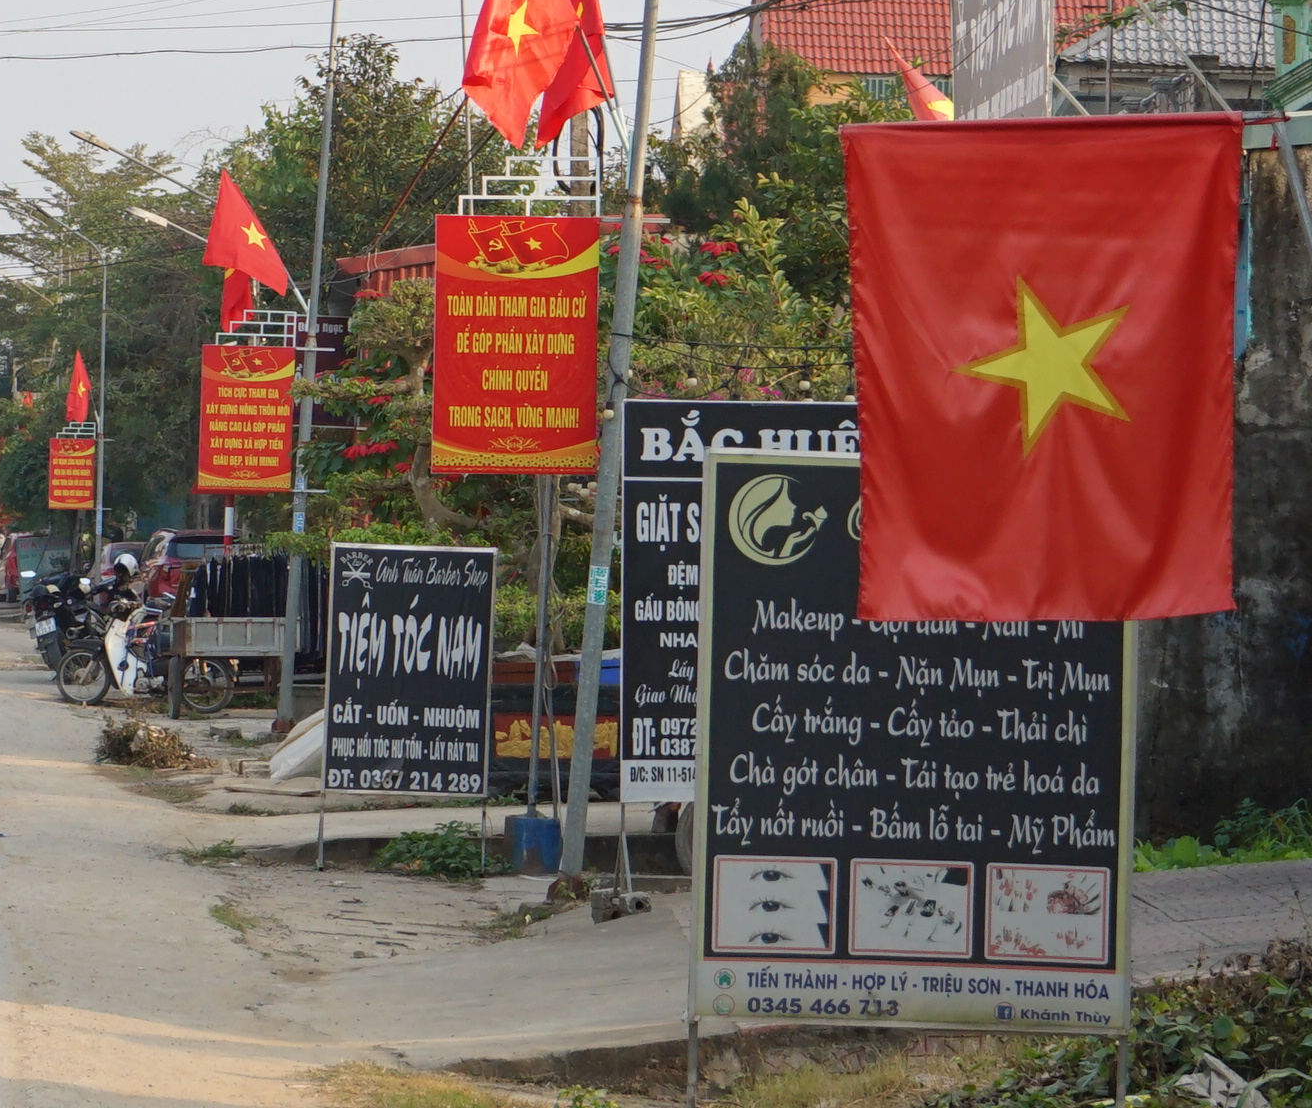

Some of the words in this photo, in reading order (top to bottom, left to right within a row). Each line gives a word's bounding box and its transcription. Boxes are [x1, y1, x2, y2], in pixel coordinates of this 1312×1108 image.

[447, 291, 473, 316] TOÀN
[476, 291, 496, 317] DÂN
[499, 296, 527, 317] THAM
[530, 296, 547, 317] GIA
[572, 290, 587, 318] CỬ
[322, 323, 344, 335] Ngọc
[457, 324, 470, 353] ĐỂ
[473, 328, 492, 353] GÓP
[525, 329, 545, 354] XÂY
[547, 333, 575, 359] DỰNG
[218, 385, 232, 398] TÍCH
[248, 388, 267, 399] THAM
[268, 388, 279, 399] GIA
[482, 365, 513, 391] CHÍNH
[206, 401, 218, 414] XÂY
[220, 403, 238, 417] DỰNG
[239, 403, 258, 415] NÔNG
[259, 404, 276, 416] THÔN
[449, 406, 481, 427] TRONG
[484, 406, 513, 432] SẠCH,
[517, 403, 543, 428] VỮNG
[546, 407, 579, 433] MẠNH!
[209, 419, 228, 432] NÂNG
[229, 421, 243, 432] CAO
[252, 420, 266, 433] GÓP
[640, 409, 744, 462] BẮC
[210, 436, 223, 448] XÂY
[224, 437, 243, 451] DỰNG
[259, 456, 280, 467] MINH!
[636, 493, 681, 552] GIẶT
[686, 502, 701, 543] S
[340, 551, 374, 566] BARBER
[425, 557, 461, 586] Barber
[463, 558, 488, 593] Shop
[667, 560, 699, 590] ĐỆM
[634, 593, 663, 622] GẤU
[752, 597, 844, 642] Makeup
[338, 591, 387, 689] TIỆM
[391, 593, 433, 676] TÓC
[436, 614, 482, 681] NAM
[724, 648, 790, 684] Chăm
[797, 653, 836, 682] sóc
[842, 651, 871, 685] da
[894, 656, 943, 695] Nặn
[949, 657, 1000, 698] Mụn
[1021, 658, 1053, 700] Trị
[1060, 661, 1111, 702] Mụn
[634, 683, 667, 708] Giao
[333, 697, 363, 724] CẮT
[377, 699, 409, 726] UỐN
[423, 705, 480, 732] NHUỘM
[752, 694, 797, 744] Cấy
[804, 696, 862, 745] trắng
[887, 698, 932, 747] Cấy
[939, 709, 974, 738] tảo
[996, 708, 1047, 743] Thải
[1054, 710, 1088, 745] chì
[331, 737, 355, 761] PHỤC
[373, 735, 389, 758] TÓC
[429, 734, 445, 761] LẤY
[447, 738, 465, 762] RÁY
[466, 742, 479, 762] TAI
[632, 718, 656, 756] ĐT:
[660, 718, 697, 735] 0972
[327, 768, 355, 788] ĐT:
[409, 771, 443, 791] 214
[447, 773, 481, 792] 289
[630, 766, 649, 782] Đ/C:
[651, 766, 664, 782] SN
[729, 751, 775, 787] Chà
[783, 757, 818, 795] gót
[824, 754, 878, 789] chân
[900, 757, 937, 788] Tái
[944, 763, 979, 800] tạo
[986, 762, 1016, 791] trẻ
[1023, 760, 1064, 795] hoá
[1071, 762, 1100, 796] da
[711, 797, 753, 847] Tẩy
[760, 798, 795, 835] nốt
[801, 799, 844, 837] ruồi
[869, 801, 921, 839] Bấm
[929, 804, 949, 840] lỗ
[956, 814, 983, 842] tai
[1007, 814, 1045, 854] Mỹ
[1051, 809, 1116, 849] Phẩm
[747, 965, 779, 989] TIẾN
[784, 969, 837, 990] THÀNH
[891, 971, 908, 992] LÝ
[922, 972, 963, 997] TRIỆU
[968, 976, 1001, 995] SƠN
[1015, 980, 1069, 998] THANH
[1074, 978, 1109, 1000] HÓA
[747, 997, 802, 1014] 0345
[809, 999, 851, 1015] 466
[1020, 1009, 1070, 1022] Khánh
[1075, 1011, 1111, 1025] Thùy
